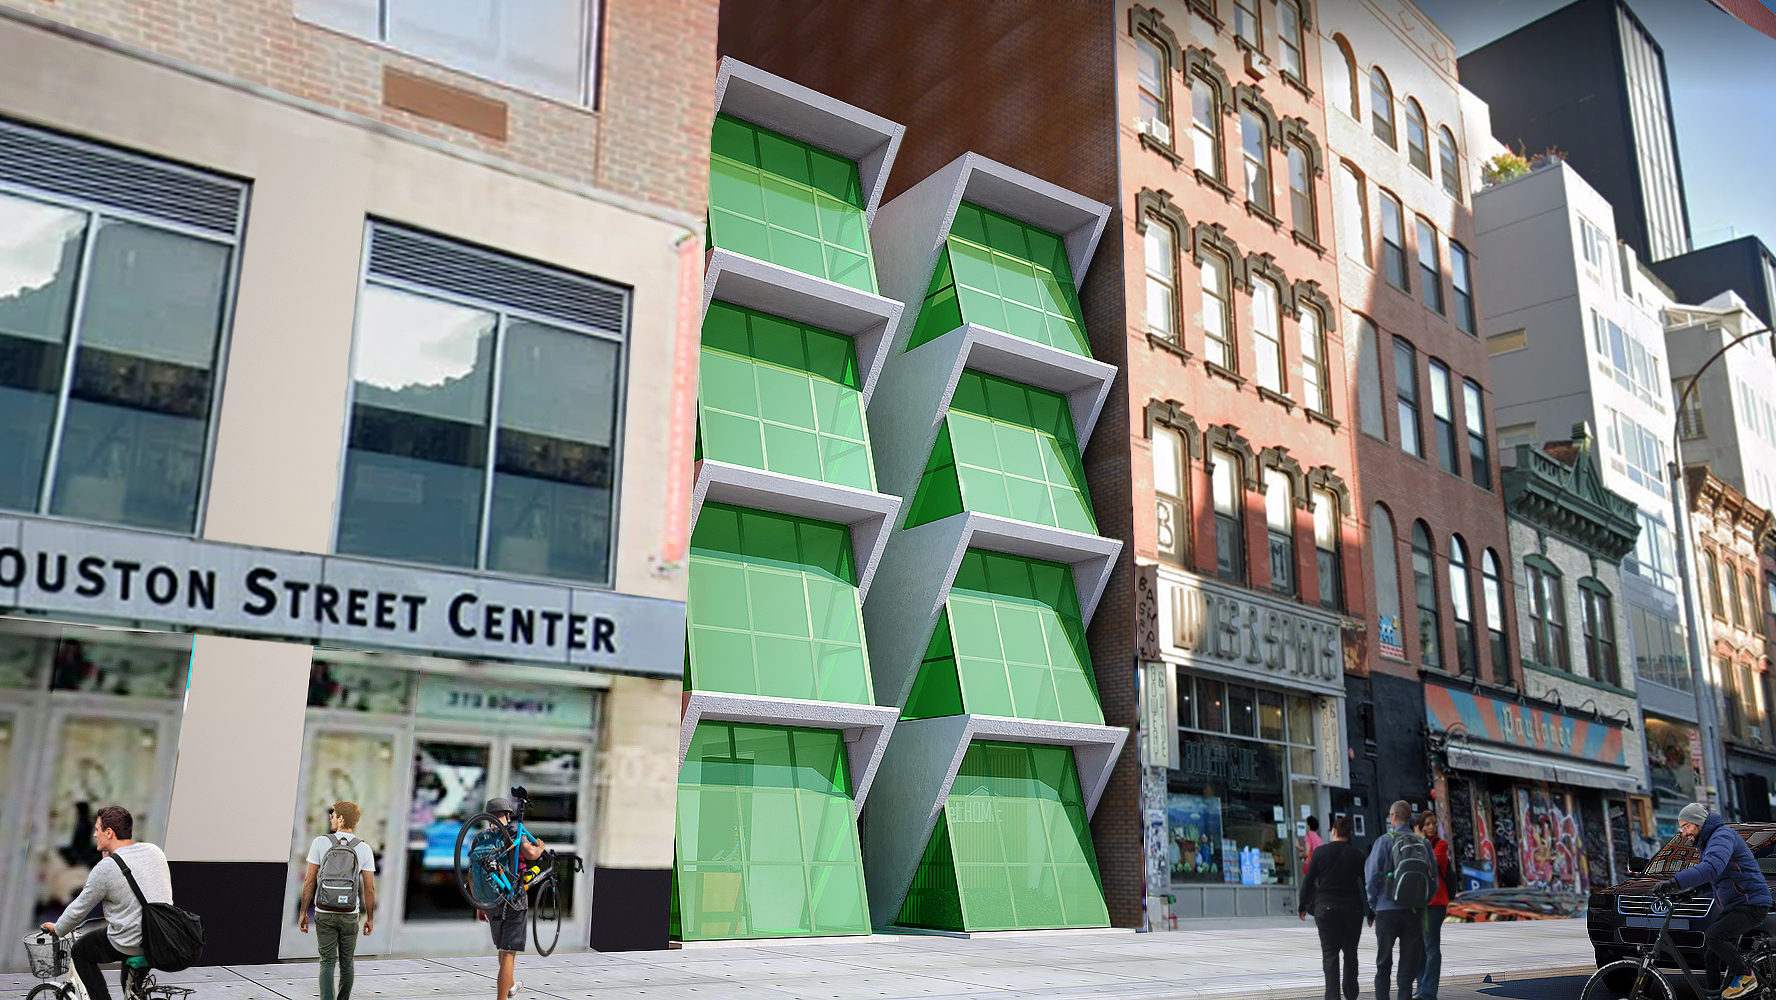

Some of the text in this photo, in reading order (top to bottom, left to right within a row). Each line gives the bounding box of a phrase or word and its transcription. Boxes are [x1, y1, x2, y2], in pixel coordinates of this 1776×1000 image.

[0, 546, 618, 654] OUSTON STREET CENTER
[1266, 611, 1338, 681] SPIRITS
